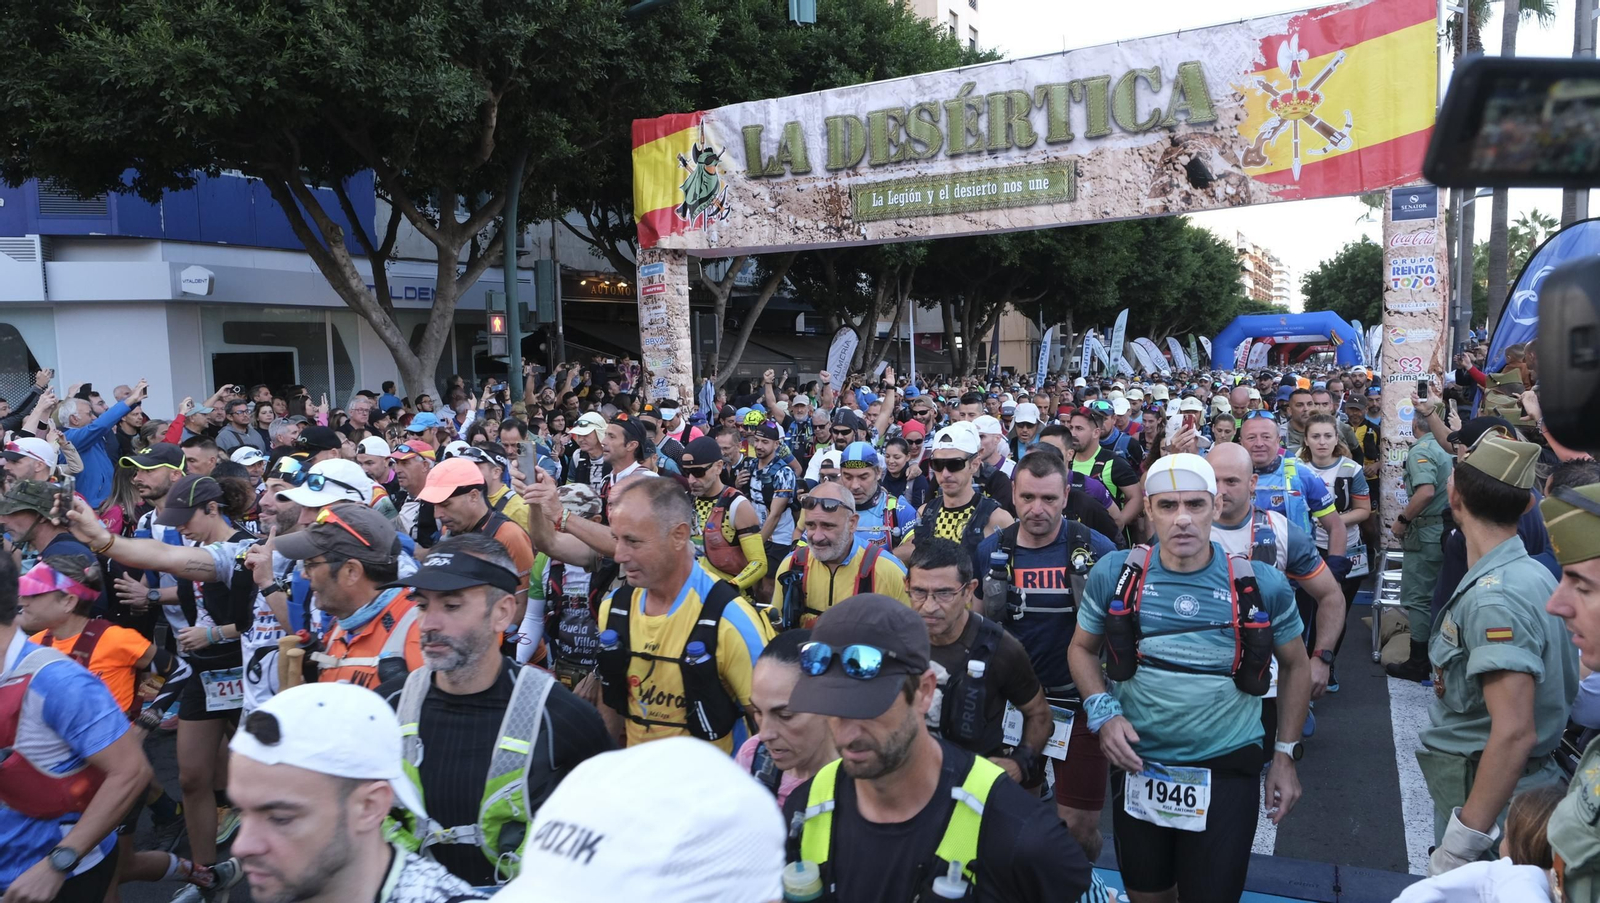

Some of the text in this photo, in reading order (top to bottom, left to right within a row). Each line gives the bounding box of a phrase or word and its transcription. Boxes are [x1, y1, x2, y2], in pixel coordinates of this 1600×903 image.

[740, 60, 1218, 178] LA DESÉRTICA
[872, 178, 1050, 207] La Legión y el desierto nos une
[1392, 257, 1434, 265] GRUPO
[1392, 265, 1435, 276] RENTA
[1392, 276, 1435, 289] TODO
[645, 336, 665, 345] BBVA
[217, 679, 244, 697] 211
[1145, 778, 1197, 808] 1946
